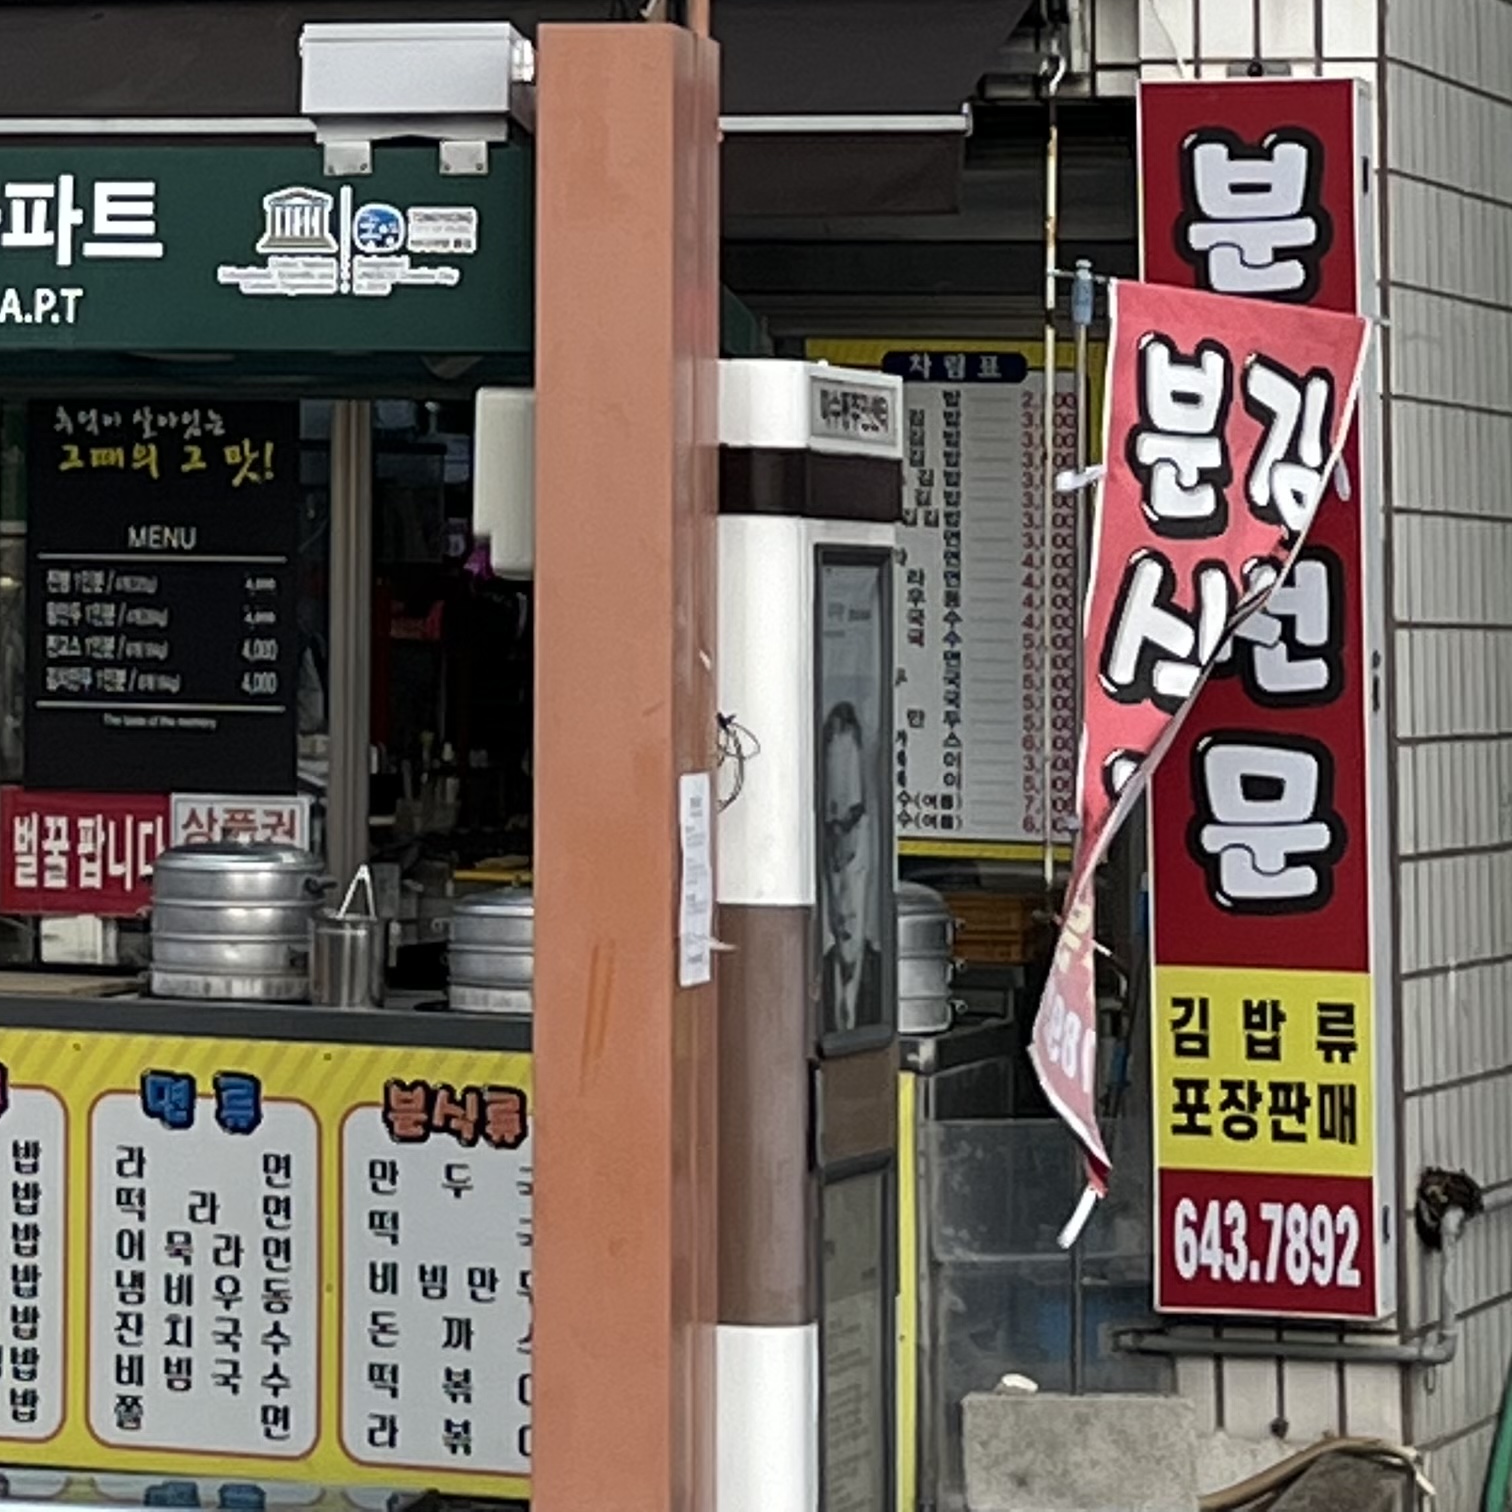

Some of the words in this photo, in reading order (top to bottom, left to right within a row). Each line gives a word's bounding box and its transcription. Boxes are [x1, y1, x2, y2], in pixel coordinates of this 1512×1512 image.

[58, 442, 160, 480] 그때의
[180, 444, 208, 473] 그
[223, 437, 275, 488] 맛!
[127, 524, 198, 551] MENU
[1170, 996, 1358, 1065] 김밥류
[383, 1077, 529, 1149] 분식류
[1170, 1077, 1358, 1146] 포장판매
[1173, 1196, 1362, 1288] 643.7892
